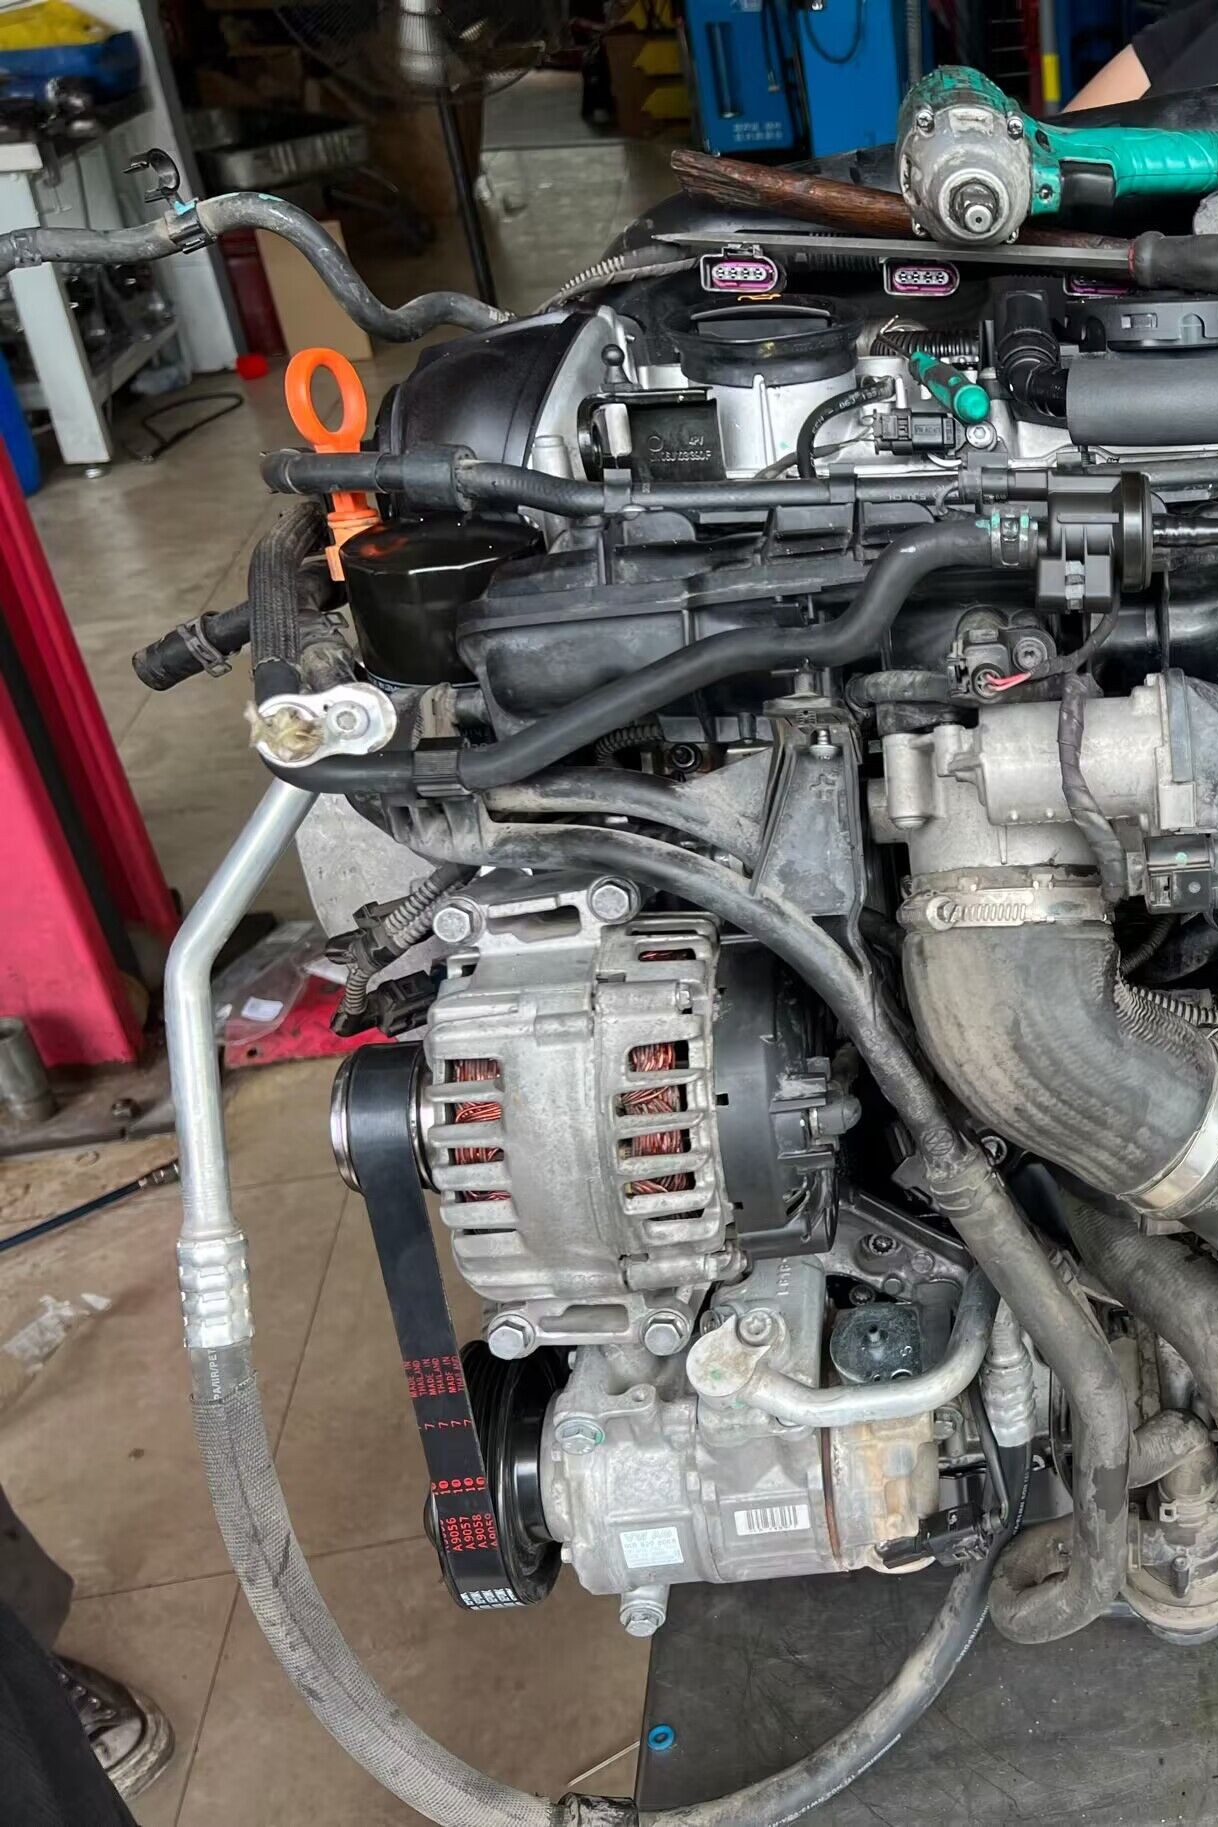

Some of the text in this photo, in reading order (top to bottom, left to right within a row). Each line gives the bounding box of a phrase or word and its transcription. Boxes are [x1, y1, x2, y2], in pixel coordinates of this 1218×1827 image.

[408, 1375, 419, 1398] MADE
[426, 1373, 438, 1396] MADE
[445, 1371, 457, 1393] MADE
[438, 1480, 451, 1495] 10
[451, 1479, 463, 1493] 10
[464, 1477, 476, 1491] 10
[446, 1517, 463, 1551] A9056
[460, 1516, 477, 1550] A9057
[472, 1514, 489, 1548] A9058
